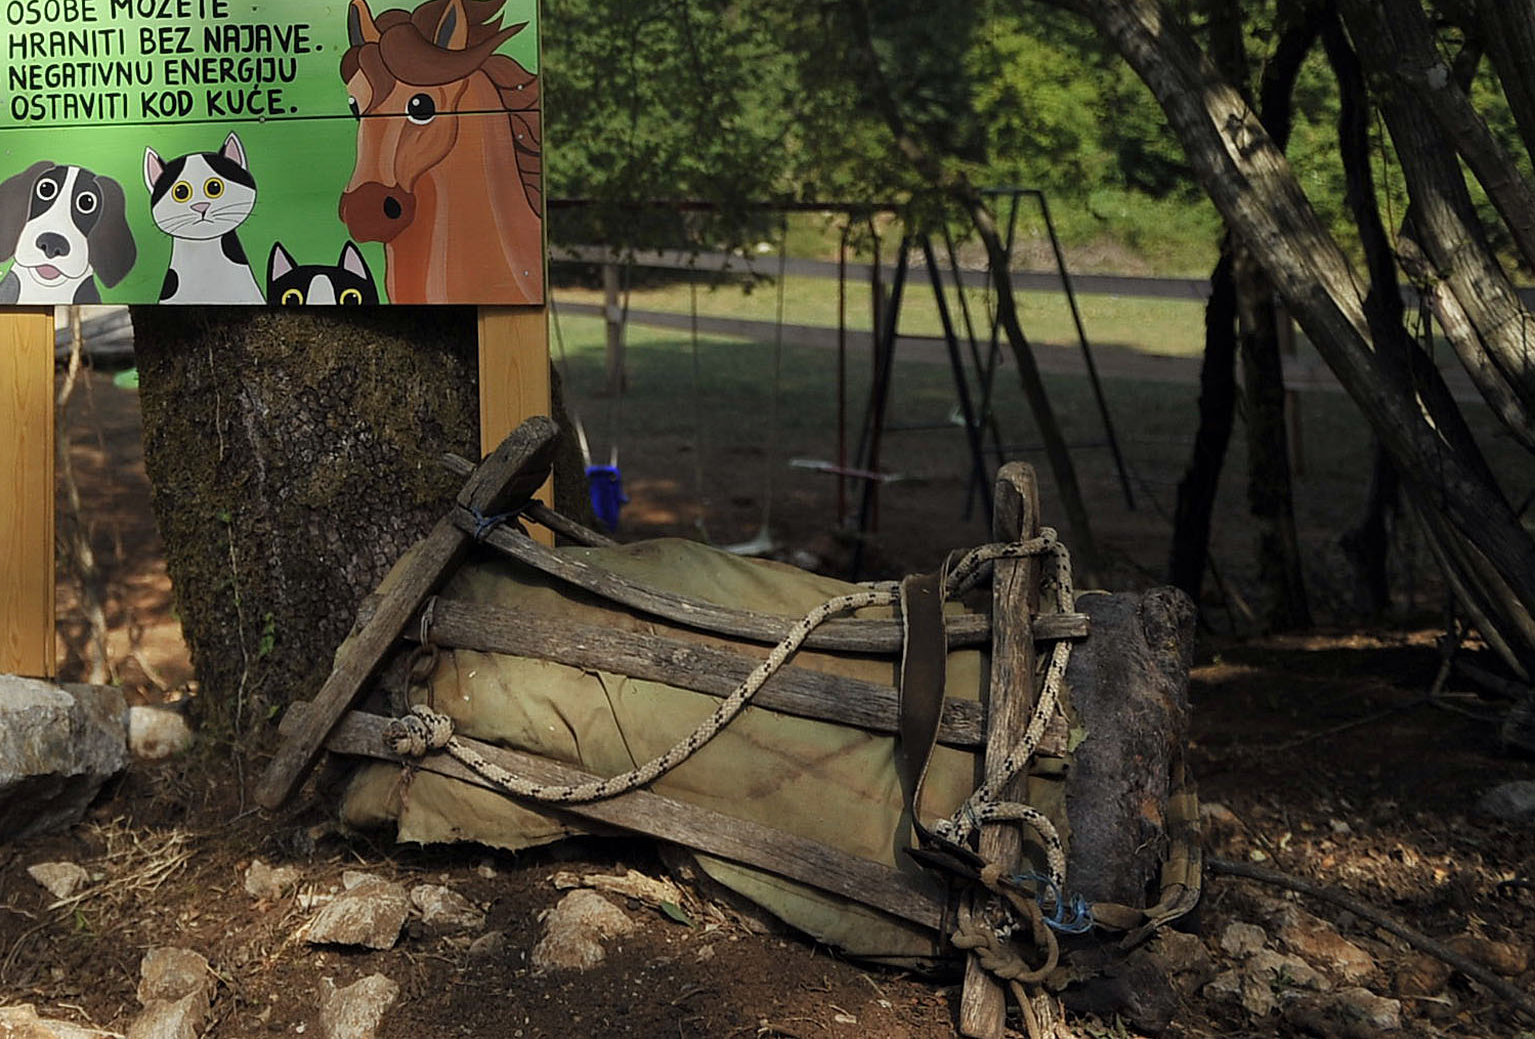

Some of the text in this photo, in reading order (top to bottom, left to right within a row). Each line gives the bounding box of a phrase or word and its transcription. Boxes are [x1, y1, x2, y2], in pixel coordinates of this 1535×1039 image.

[8, 23, 323, 60] HRANITI BEZ NAJAVE.
[8, 56, 297, 92] NEGATIVNU ENERGIJU
[10, 84, 297, 121] OSTAVITI KOD KUĆE.
